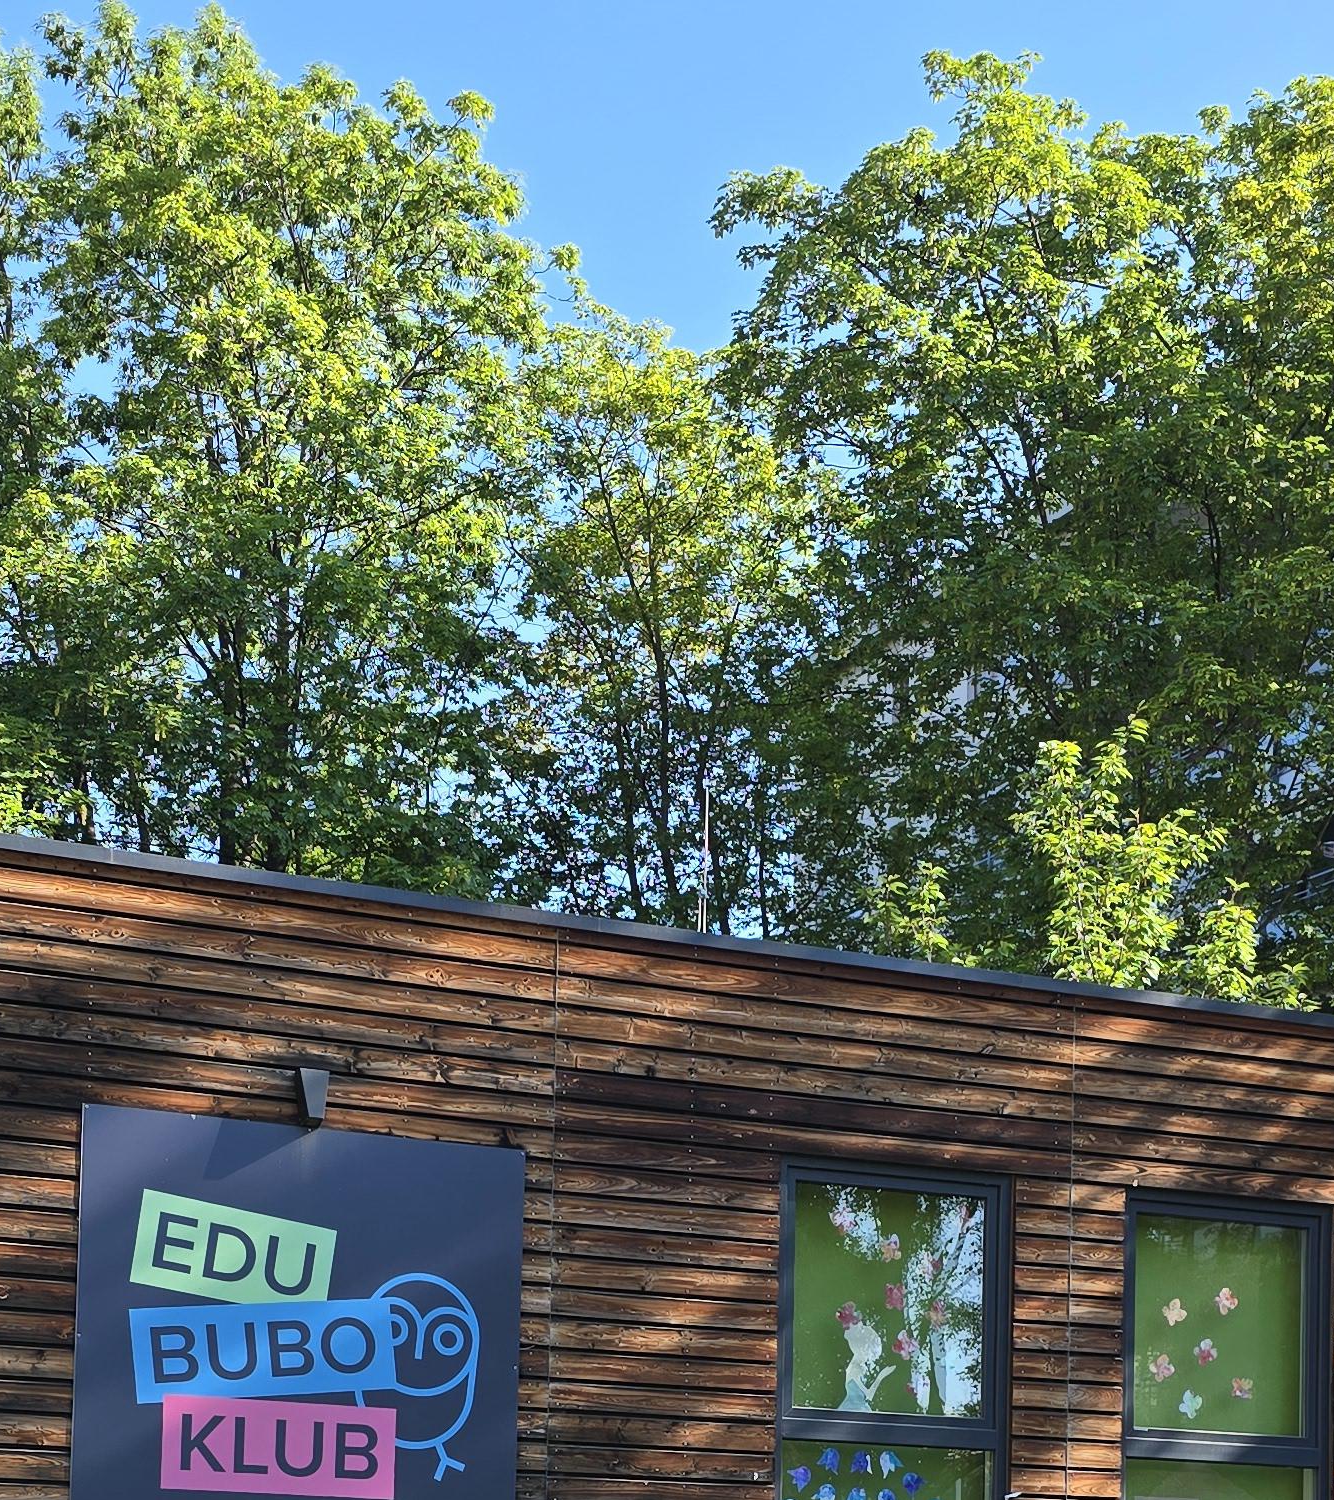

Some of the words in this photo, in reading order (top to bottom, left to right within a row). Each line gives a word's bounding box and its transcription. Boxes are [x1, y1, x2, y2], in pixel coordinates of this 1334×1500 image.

[151, 1211, 317, 1296] EDU
[148, 1316, 377, 1385] BUBO
[178, 1413, 379, 1480] KLUB
